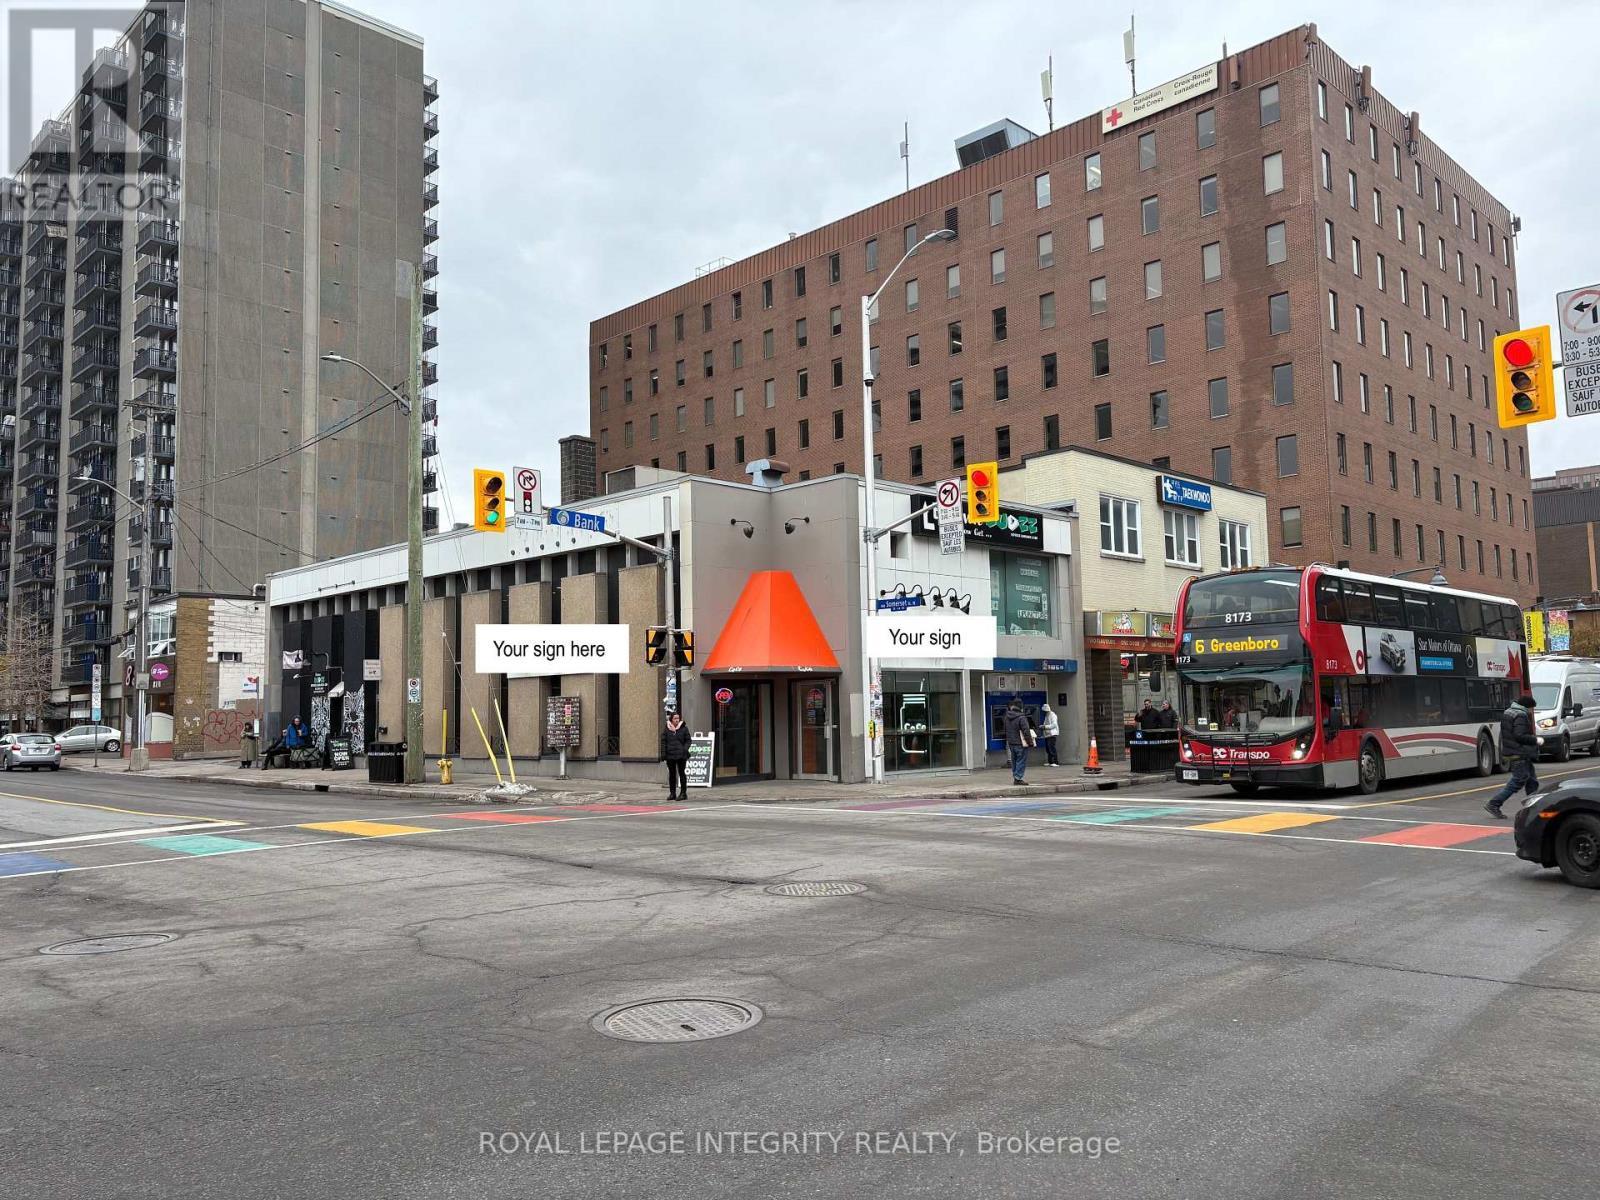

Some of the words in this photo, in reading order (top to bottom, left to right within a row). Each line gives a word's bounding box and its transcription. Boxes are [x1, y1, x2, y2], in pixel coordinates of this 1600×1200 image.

[1174, 69, 1213, 88] Croix-Rouge
[1174, 77, 1210, 95] canadienne
[1133, 90, 1162, 105] Canadian
[1134, 103, 1146, 112] Red
[1146, 97, 1164, 107] Cross
[1564, 340, 1579, 351] 7:00
[1565, 351, 1580, 362] 3:30
[1572, 389, 1595, 401] SAUF
[1182, 487, 1210, 504] TAEKWONDO
[574, 514, 600, 531] Bank
[1225, 612, 1252, 623] 8173
[1195, 639, 1204, 653] 6
[1211, 636, 1279, 652] Greenboro
[1428, 638, 1443, 652] Motors
[1448, 640, 1462, 653] Ottawa
[1228, 749, 1270, 760] Transpo
